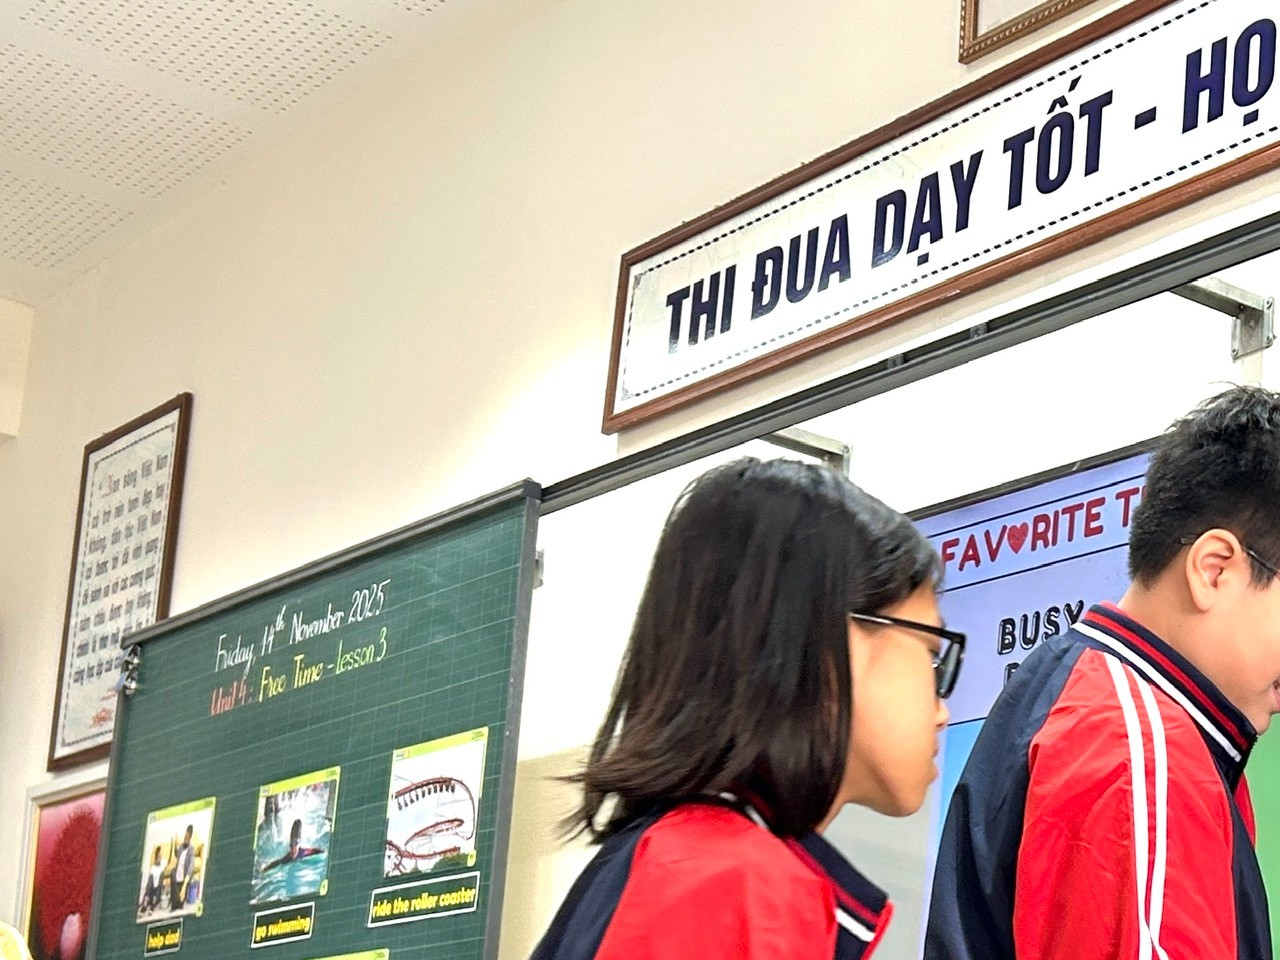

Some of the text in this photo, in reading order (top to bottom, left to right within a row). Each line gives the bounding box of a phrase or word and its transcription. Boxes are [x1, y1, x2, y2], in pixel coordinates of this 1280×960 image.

[666, 264, 736, 354] THI
[750, 213, 852, 320] ĐUA
[871, 150, 985, 266] DẠY
[1003, 76, 1114, 209] TỐT
[289, 602, 345, 645] November
[348, 578, 392, 624] 2025
[997, 600, 1085, 656] BUSY
[259, 666, 287, 702] Free
[293, 653, 324, 689] Time
[377, 627, 388, 662] 3
[372, 886, 476, 918] ride the roller coaster
[255, 925, 266, 941] go
